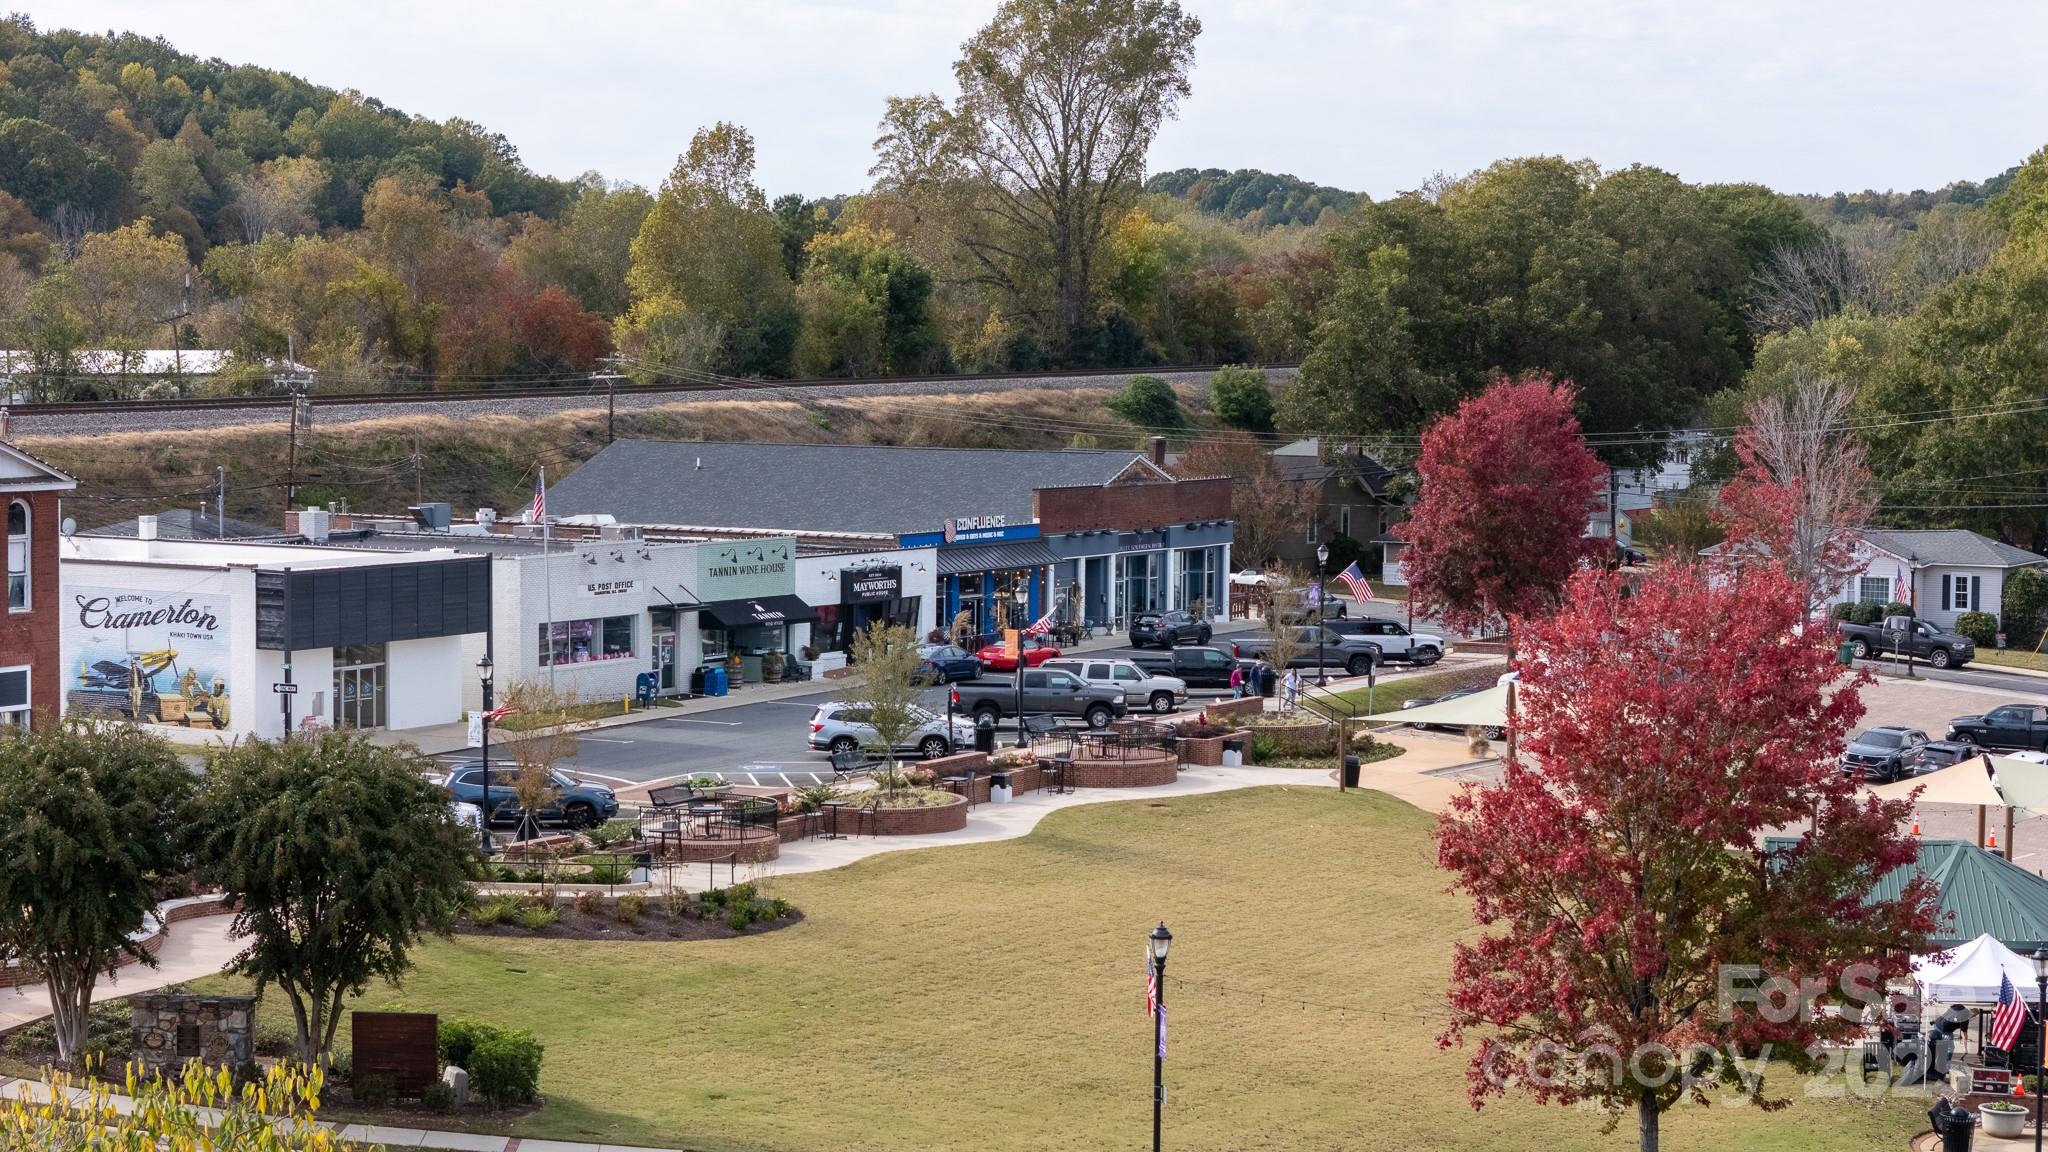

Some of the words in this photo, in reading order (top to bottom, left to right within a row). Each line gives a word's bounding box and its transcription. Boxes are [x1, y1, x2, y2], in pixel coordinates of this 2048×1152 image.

[956, 515, 1006, 531] CONFLUENCE
[709, 566, 737, 577] TANNIN
[739, 564, 759, 575] WINE
[760, 562, 786, 574] HOUSE
[598, 582, 612, 590] POST
[614, 580, 634, 589] OFFICE
[114, 595, 143, 603] WELCOME
[145, 596, 153, 605] TO
[75, 594, 220, 631] Cramerton
[752, 611, 785, 620] TANNIN
[187, 632, 202, 640] TOWN
